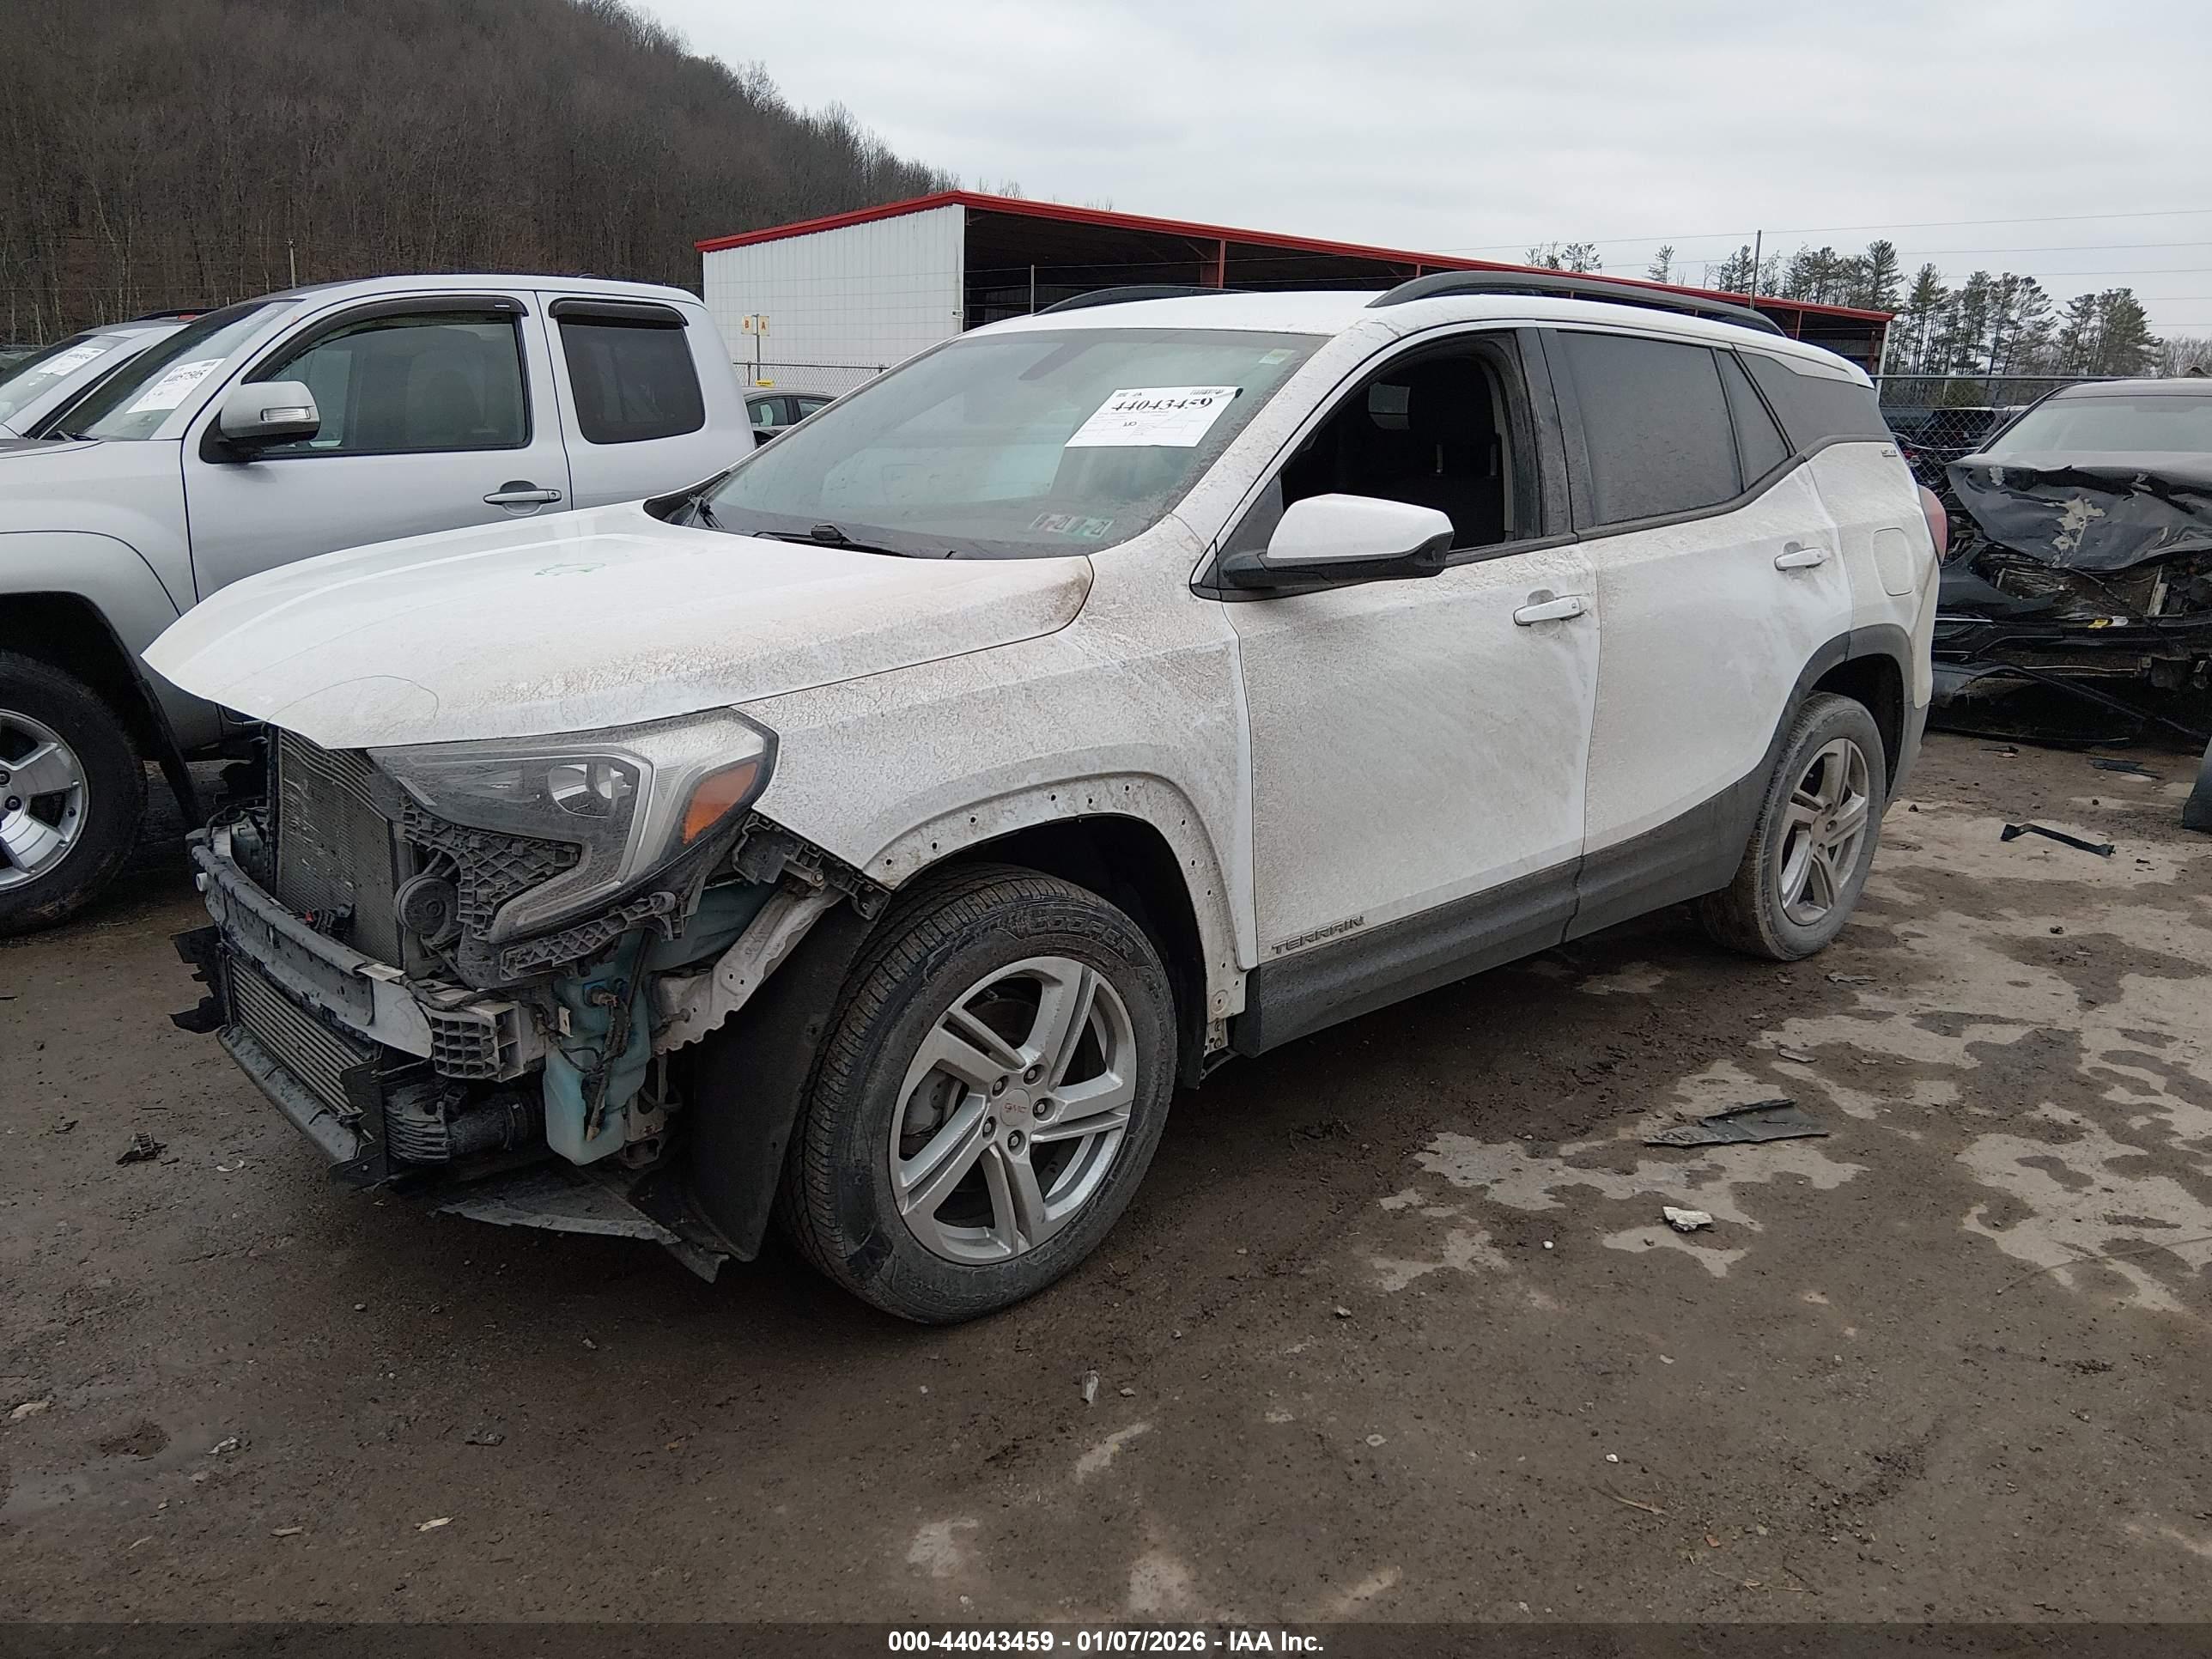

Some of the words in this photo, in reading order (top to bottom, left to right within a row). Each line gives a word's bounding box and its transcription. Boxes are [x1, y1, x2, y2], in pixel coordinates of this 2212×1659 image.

[744, 320, 750, 329] B
[761, 321, 766, 330] A
[1271, 914, 1364, 954] TERRAIN
[1004, 1103, 1027, 1114] GMC
